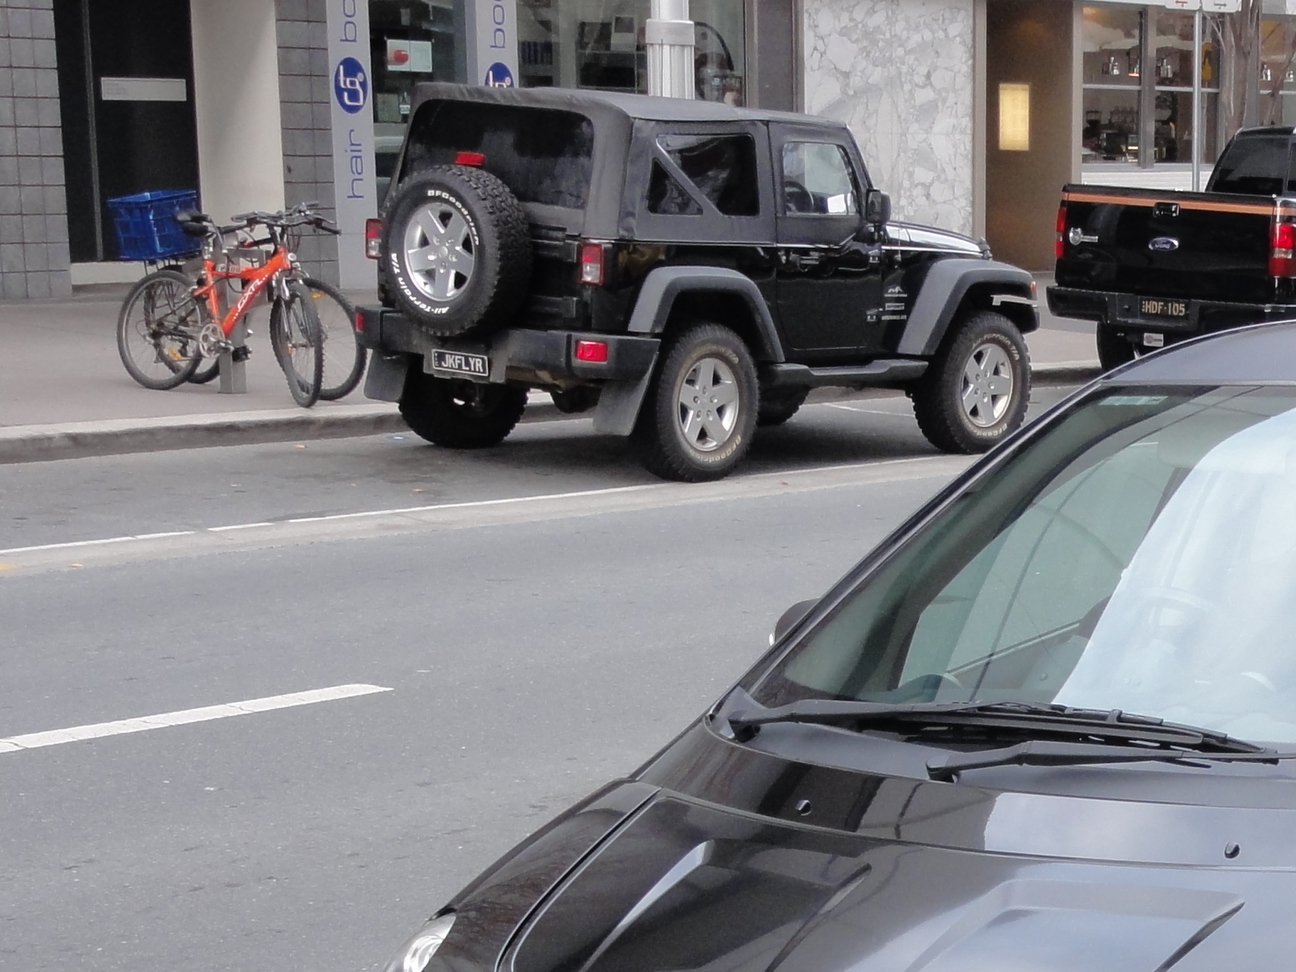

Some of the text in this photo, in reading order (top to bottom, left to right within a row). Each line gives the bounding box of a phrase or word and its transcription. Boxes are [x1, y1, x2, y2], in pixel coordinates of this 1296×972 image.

[345, 129, 365, 199] hair
[427, 190, 480, 246] BFGoodrich
[441, 353, 484, 373] JKFLYR
